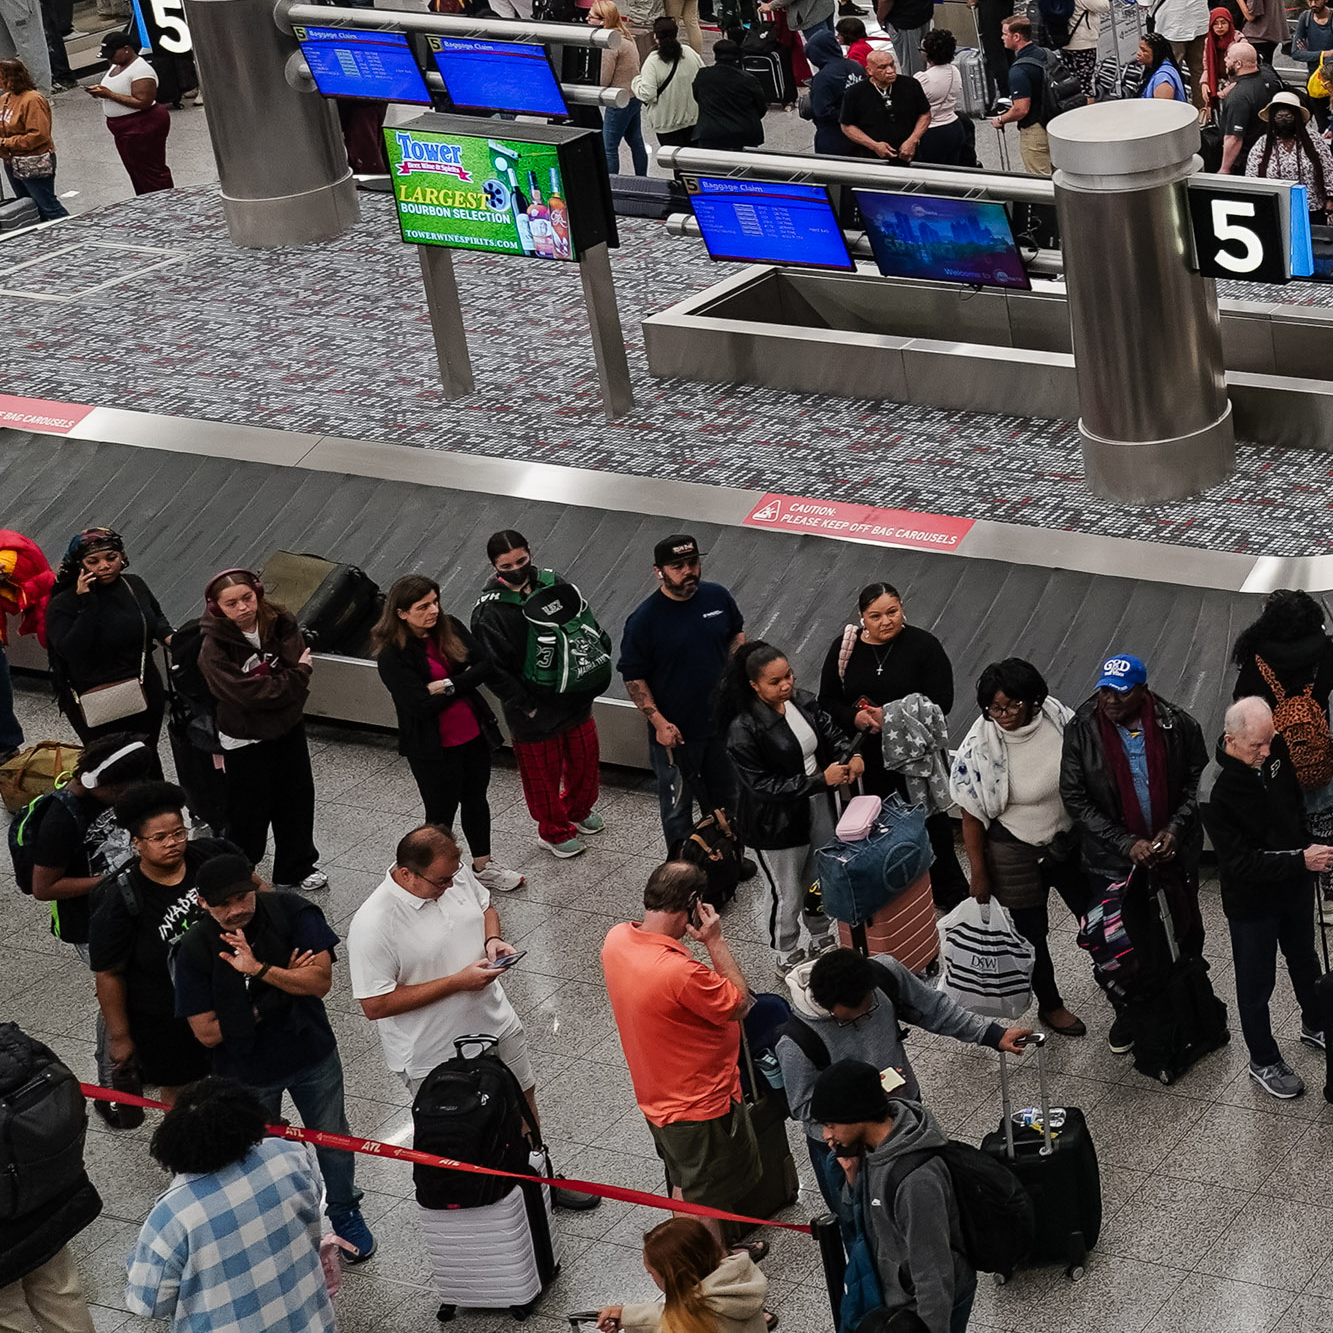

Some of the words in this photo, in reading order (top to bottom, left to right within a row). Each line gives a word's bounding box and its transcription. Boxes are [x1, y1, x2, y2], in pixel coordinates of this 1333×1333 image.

[296, 27, 305, 40] 5
[308, 30, 336, 41] Baggage
[337, 32, 357, 40] Claim
[430, 37, 441, 50] 5
[443, 40, 473, 52] Baggage
[474, 43, 494, 51] Claim
[396, 131, 462, 164] Tower
[686, 177, 698, 192] 5
[702, 181, 739, 192] Baggage
[740, 184, 763, 192] Claim
[399, 185, 491, 211] LARGEST
[400, 203, 450, 218] BOURBON
[453, 207, 510, 225] SELECTION
[405, 229, 518, 250] TOWERWINESPIRITS.COM
[1211, 199, 1264, 273] 5
[943, 266, 982, 279] Welcome
[3, 411, 24, 422] BAG
[22, 414, 75, 428] CAROUSELS
[789, 503, 836, 516] CAUTION:
[780, 514, 818, 527] PLEASE
[820, 518, 849, 530] KEEP
[849, 522, 872, 533] OFF
[871, 525, 894, 537] BAG
[894, 528, 958, 545] CAROUSELS
[972, 955, 997, 969] DSW
[285, 1126, 304, 1138] ATL
[361, 1141, 381, 1153] ATL
